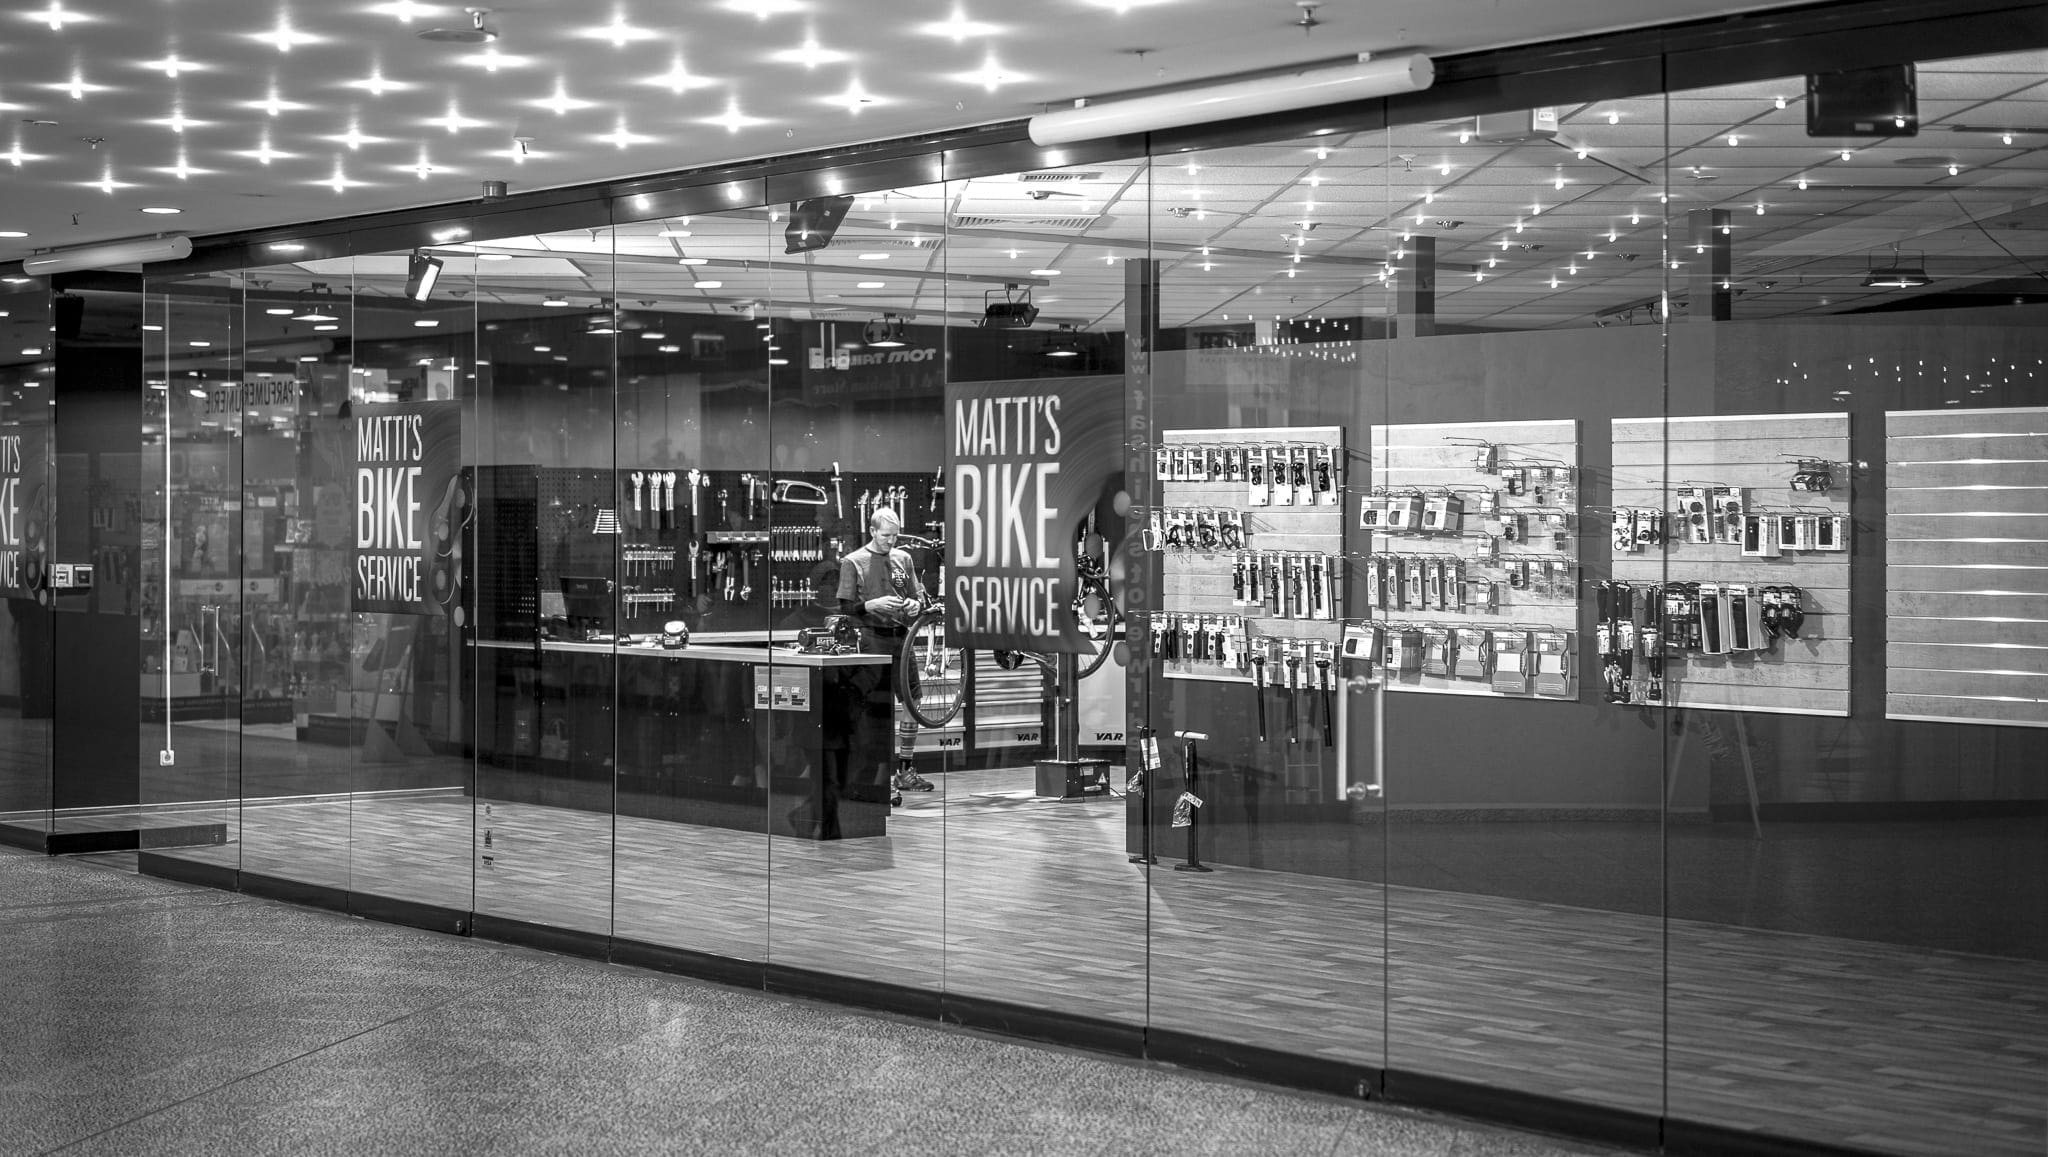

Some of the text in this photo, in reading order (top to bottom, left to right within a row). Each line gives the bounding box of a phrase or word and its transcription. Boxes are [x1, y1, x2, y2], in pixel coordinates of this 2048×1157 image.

[357, 414, 423, 463] MATTI'S
[955, 394, 1061, 457] MATTI'S
[357, 466, 422, 550] BIKE
[955, 462, 1061, 569] BIKE
[357, 555, 422, 602] SERVICE
[955, 575, 1061, 638] SERVICE
[938, 737, 961, 747] VAR
[1016, 733, 1039, 742] VAR
[1095, 732, 1124, 741] VAR
